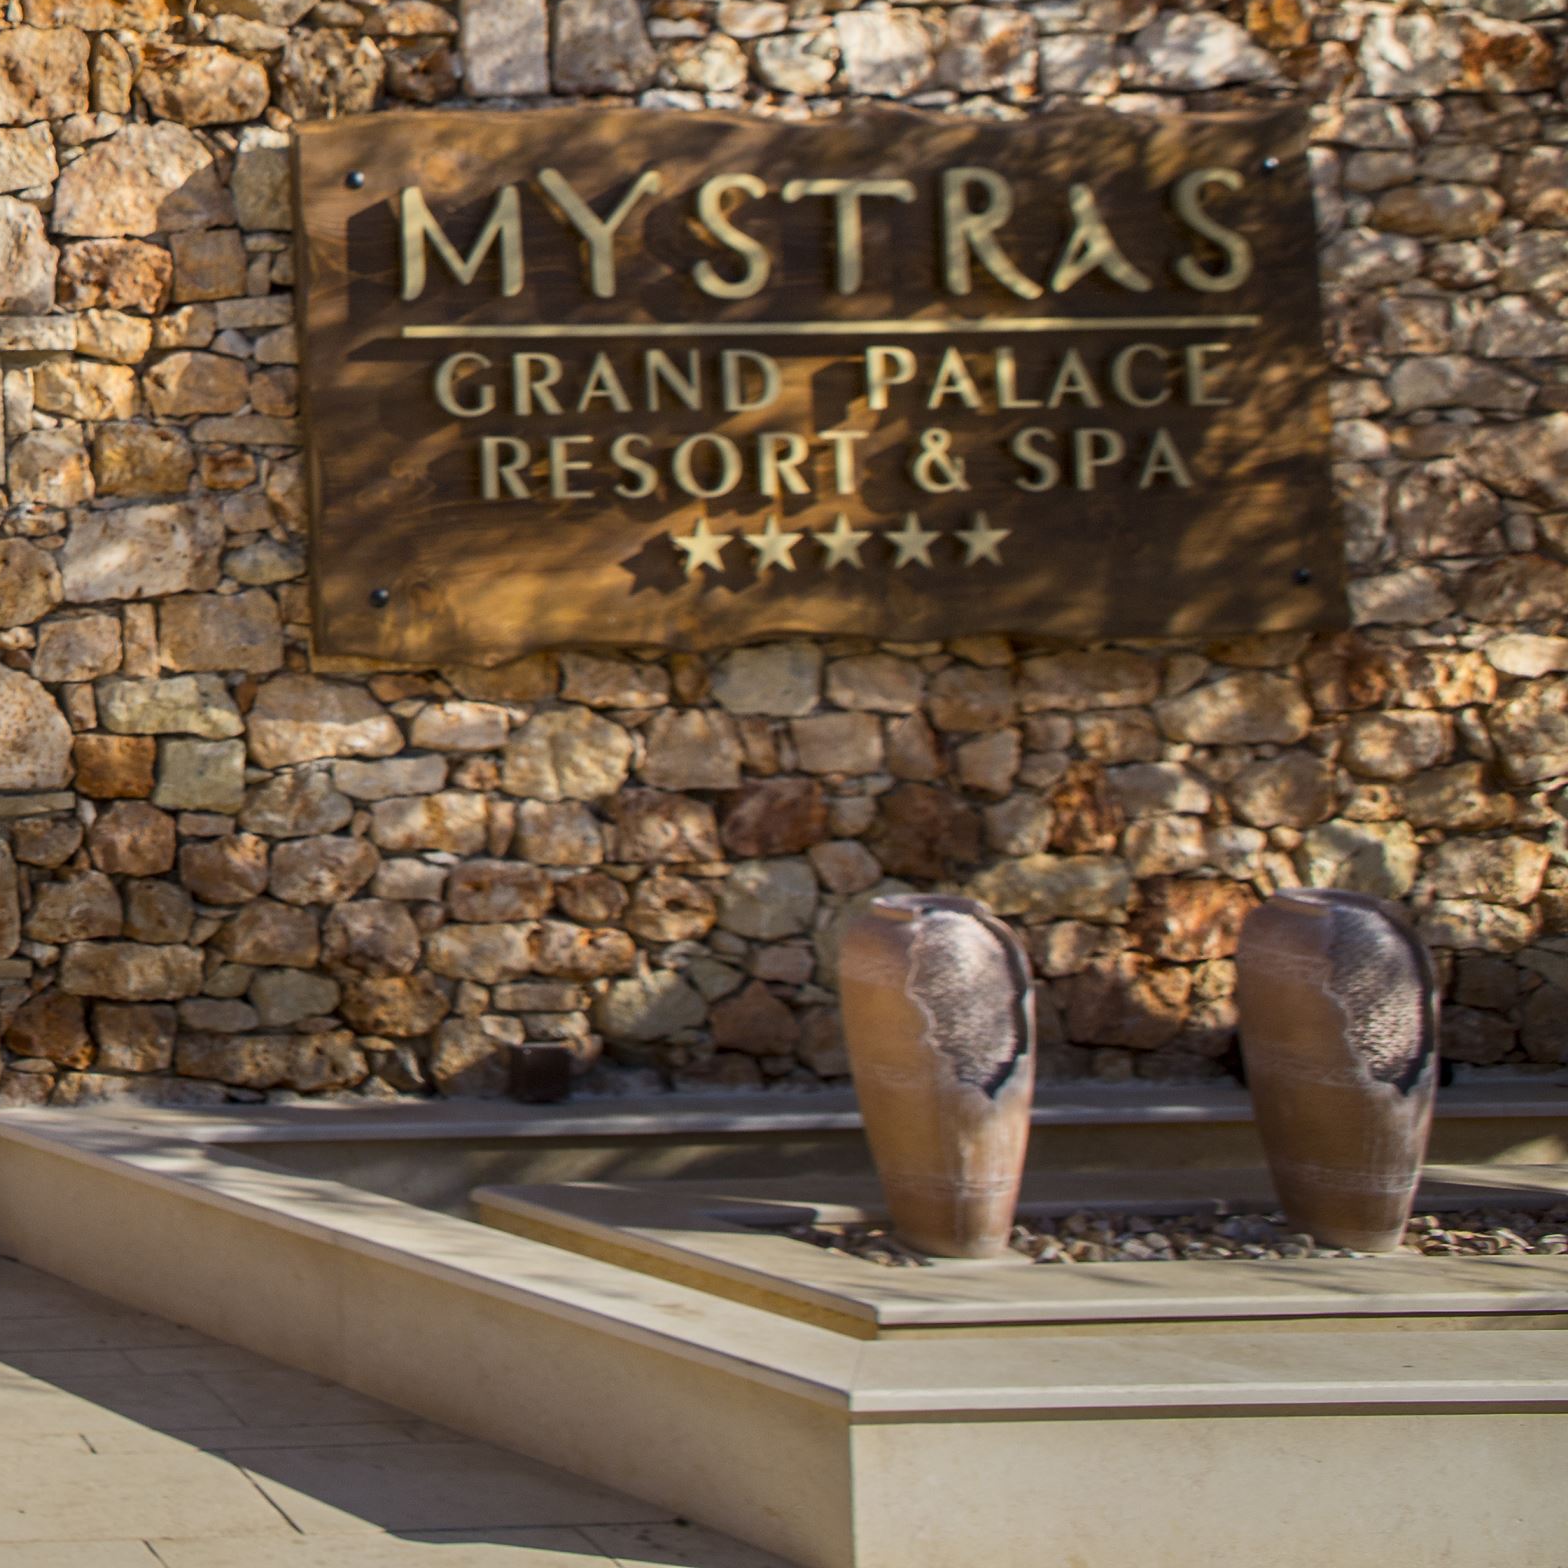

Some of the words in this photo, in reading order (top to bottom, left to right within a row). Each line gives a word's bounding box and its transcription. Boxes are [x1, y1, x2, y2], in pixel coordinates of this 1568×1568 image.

[401, 167, 1254, 299] MYSTRAS
[434, 348, 783, 416] GRAND
[864, 342, 1234, 410] PALACE
[481, 431, 868, 499] RESORT
[912, 427, 970, 493] &
[1010, 427, 1194, 492] SPA
